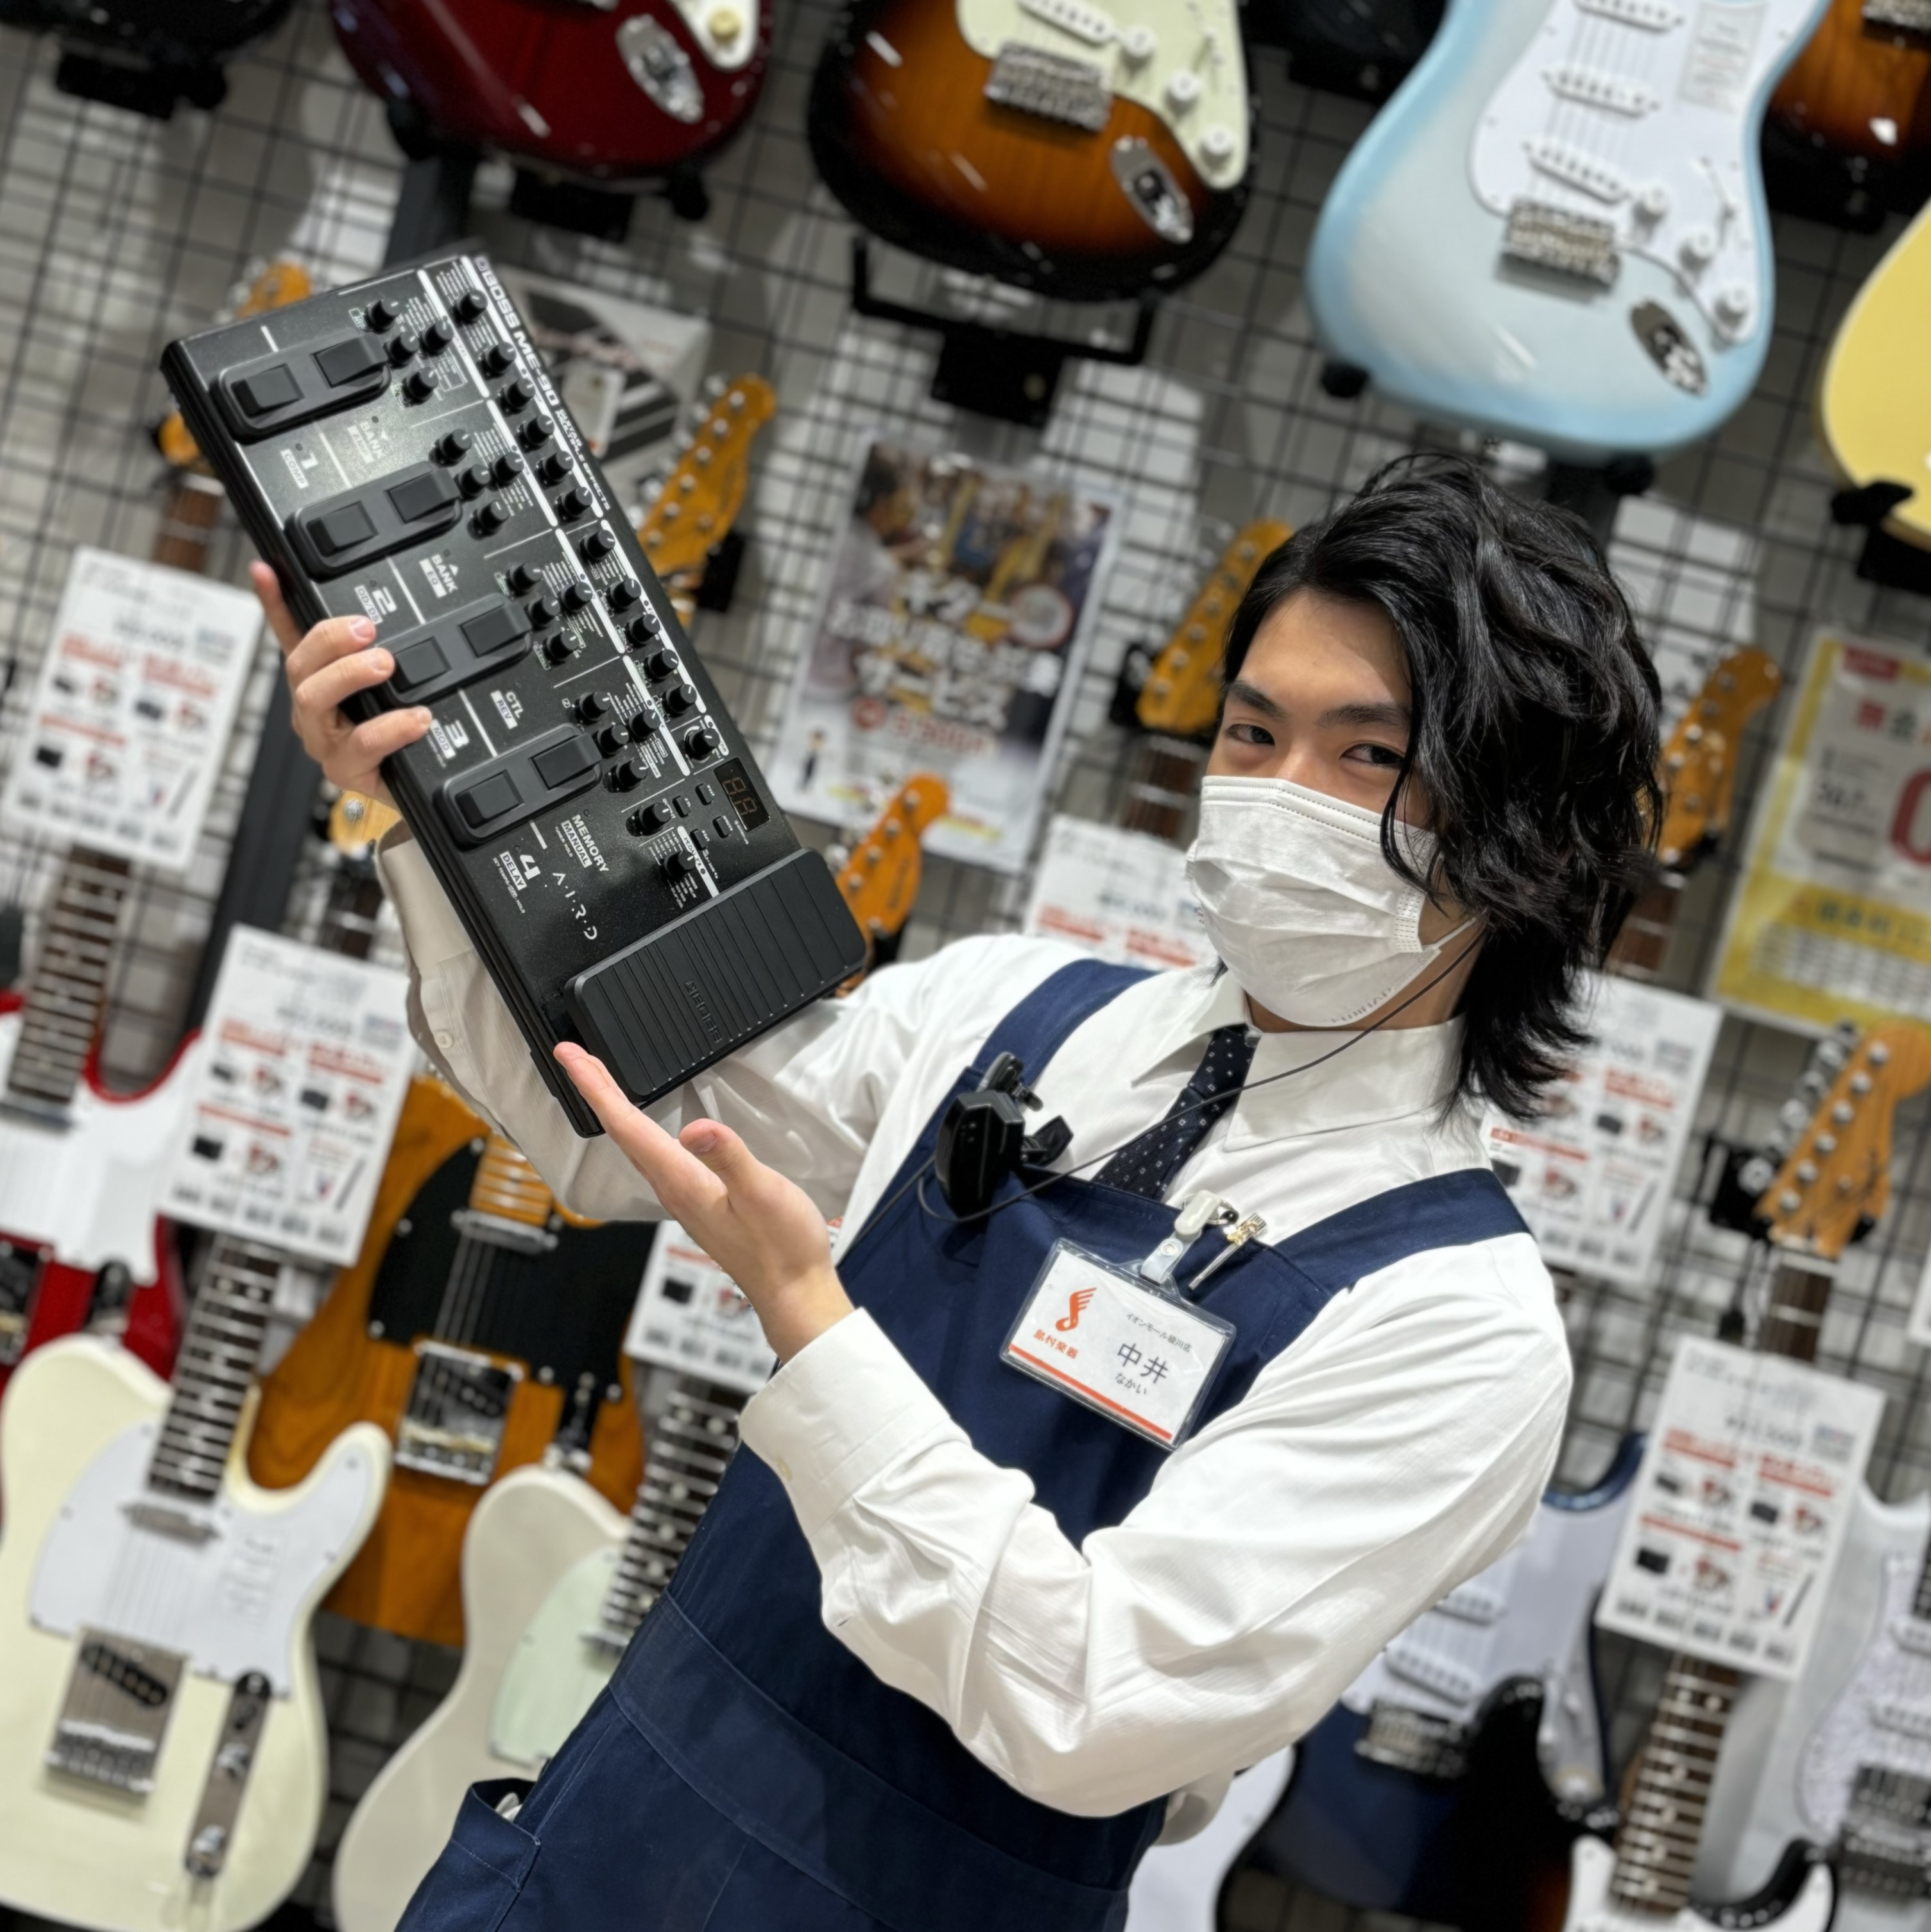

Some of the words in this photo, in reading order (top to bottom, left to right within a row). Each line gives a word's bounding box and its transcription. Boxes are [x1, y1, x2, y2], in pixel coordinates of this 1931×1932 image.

[482, 270, 519, 327] BOSS
[513, 331, 559, 405] ME-90
[359, 421, 385, 459] BANK
[284, 453, 304, 483] COMP
[301, 453, 318, 469] 1
[427, 571, 438, 585] EQ
[431, 554, 456, 592] BANK
[357, 588, 379, 621] OD/DS
[372, 587, 396, 614] 2
[496, 699, 511, 718] REV
[506, 691, 523, 718] CTL
[433, 727, 449, 750] MOD
[445, 721, 468, 747] 3
[563, 822, 588, 865] MANUAL
[572, 815, 608, 871] MEMORY
[502, 854, 524, 885] DELAY
[519, 854, 540, 879] 4
[1034, 1329, 1078, 1359] 島村楽器
[1117, 1343, 1169, 1384] 中井
[1115, 1372, 1147, 1395] なかい
